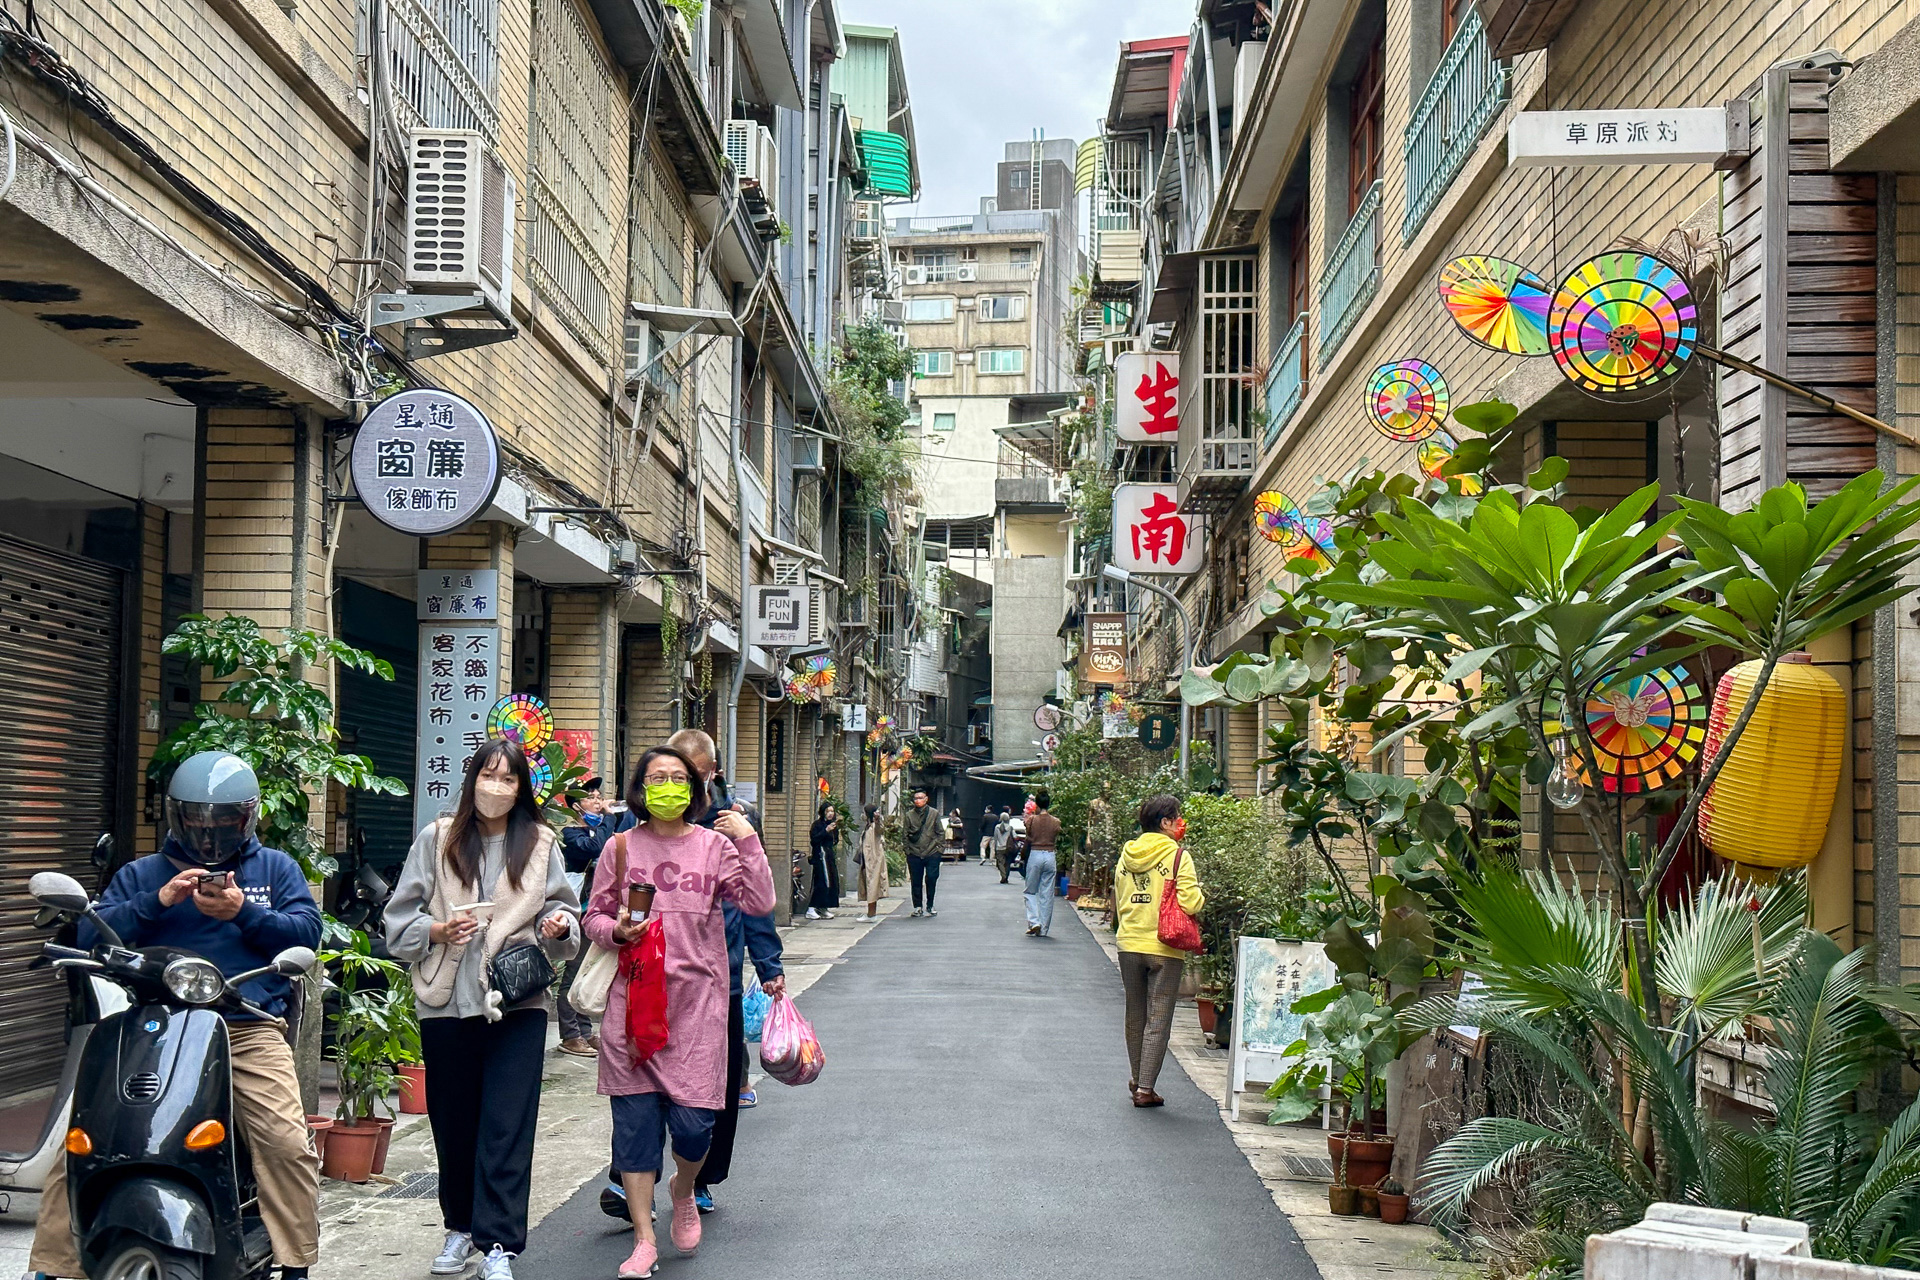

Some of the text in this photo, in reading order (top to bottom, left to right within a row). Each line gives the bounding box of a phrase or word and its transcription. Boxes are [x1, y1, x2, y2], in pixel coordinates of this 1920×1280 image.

[1134, 360, 1179, 435] 生
[393, 402, 456, 430] 星通
[386, 487, 458, 510] 傢飾布
[1130, 492, 1187, 566] 南
[441, 575, 474, 588] 星通
[768, 599, 790, 608] FUN
[768, 612, 790, 621] FUN
